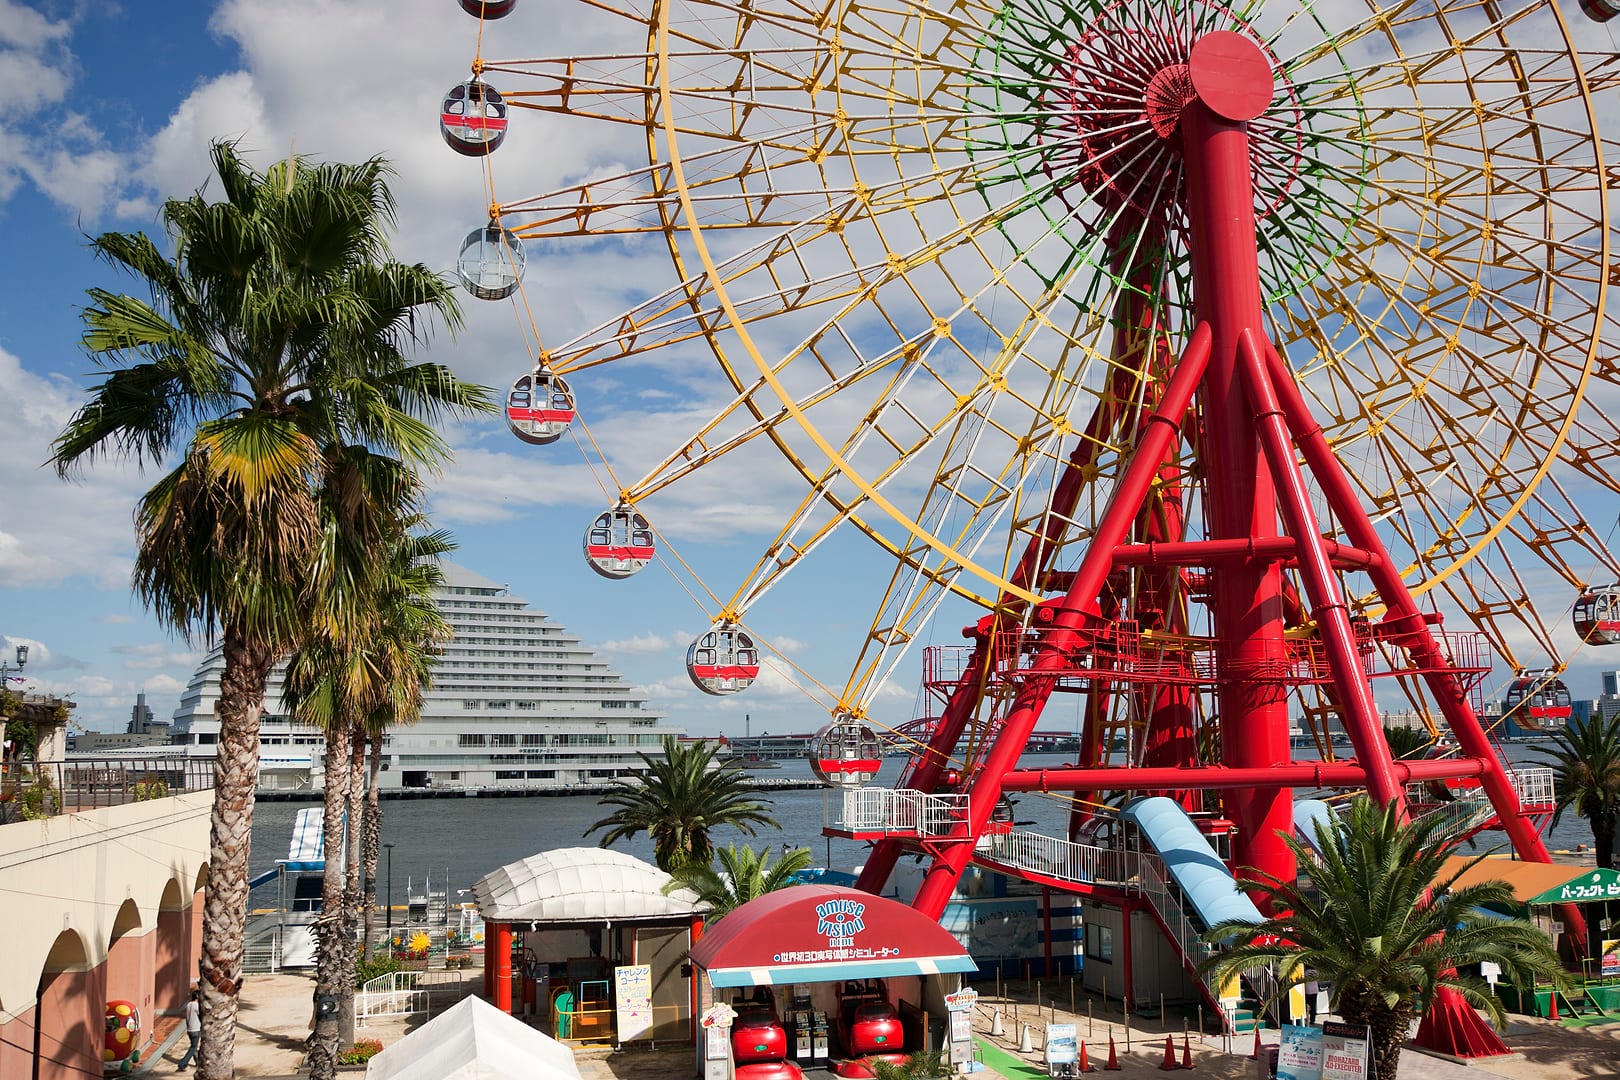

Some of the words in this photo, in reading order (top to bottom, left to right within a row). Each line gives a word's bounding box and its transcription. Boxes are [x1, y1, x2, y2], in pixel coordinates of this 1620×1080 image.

[1561, 885, 1605, 899] パーフェクト
[621, 976, 647, 985] コーナー
